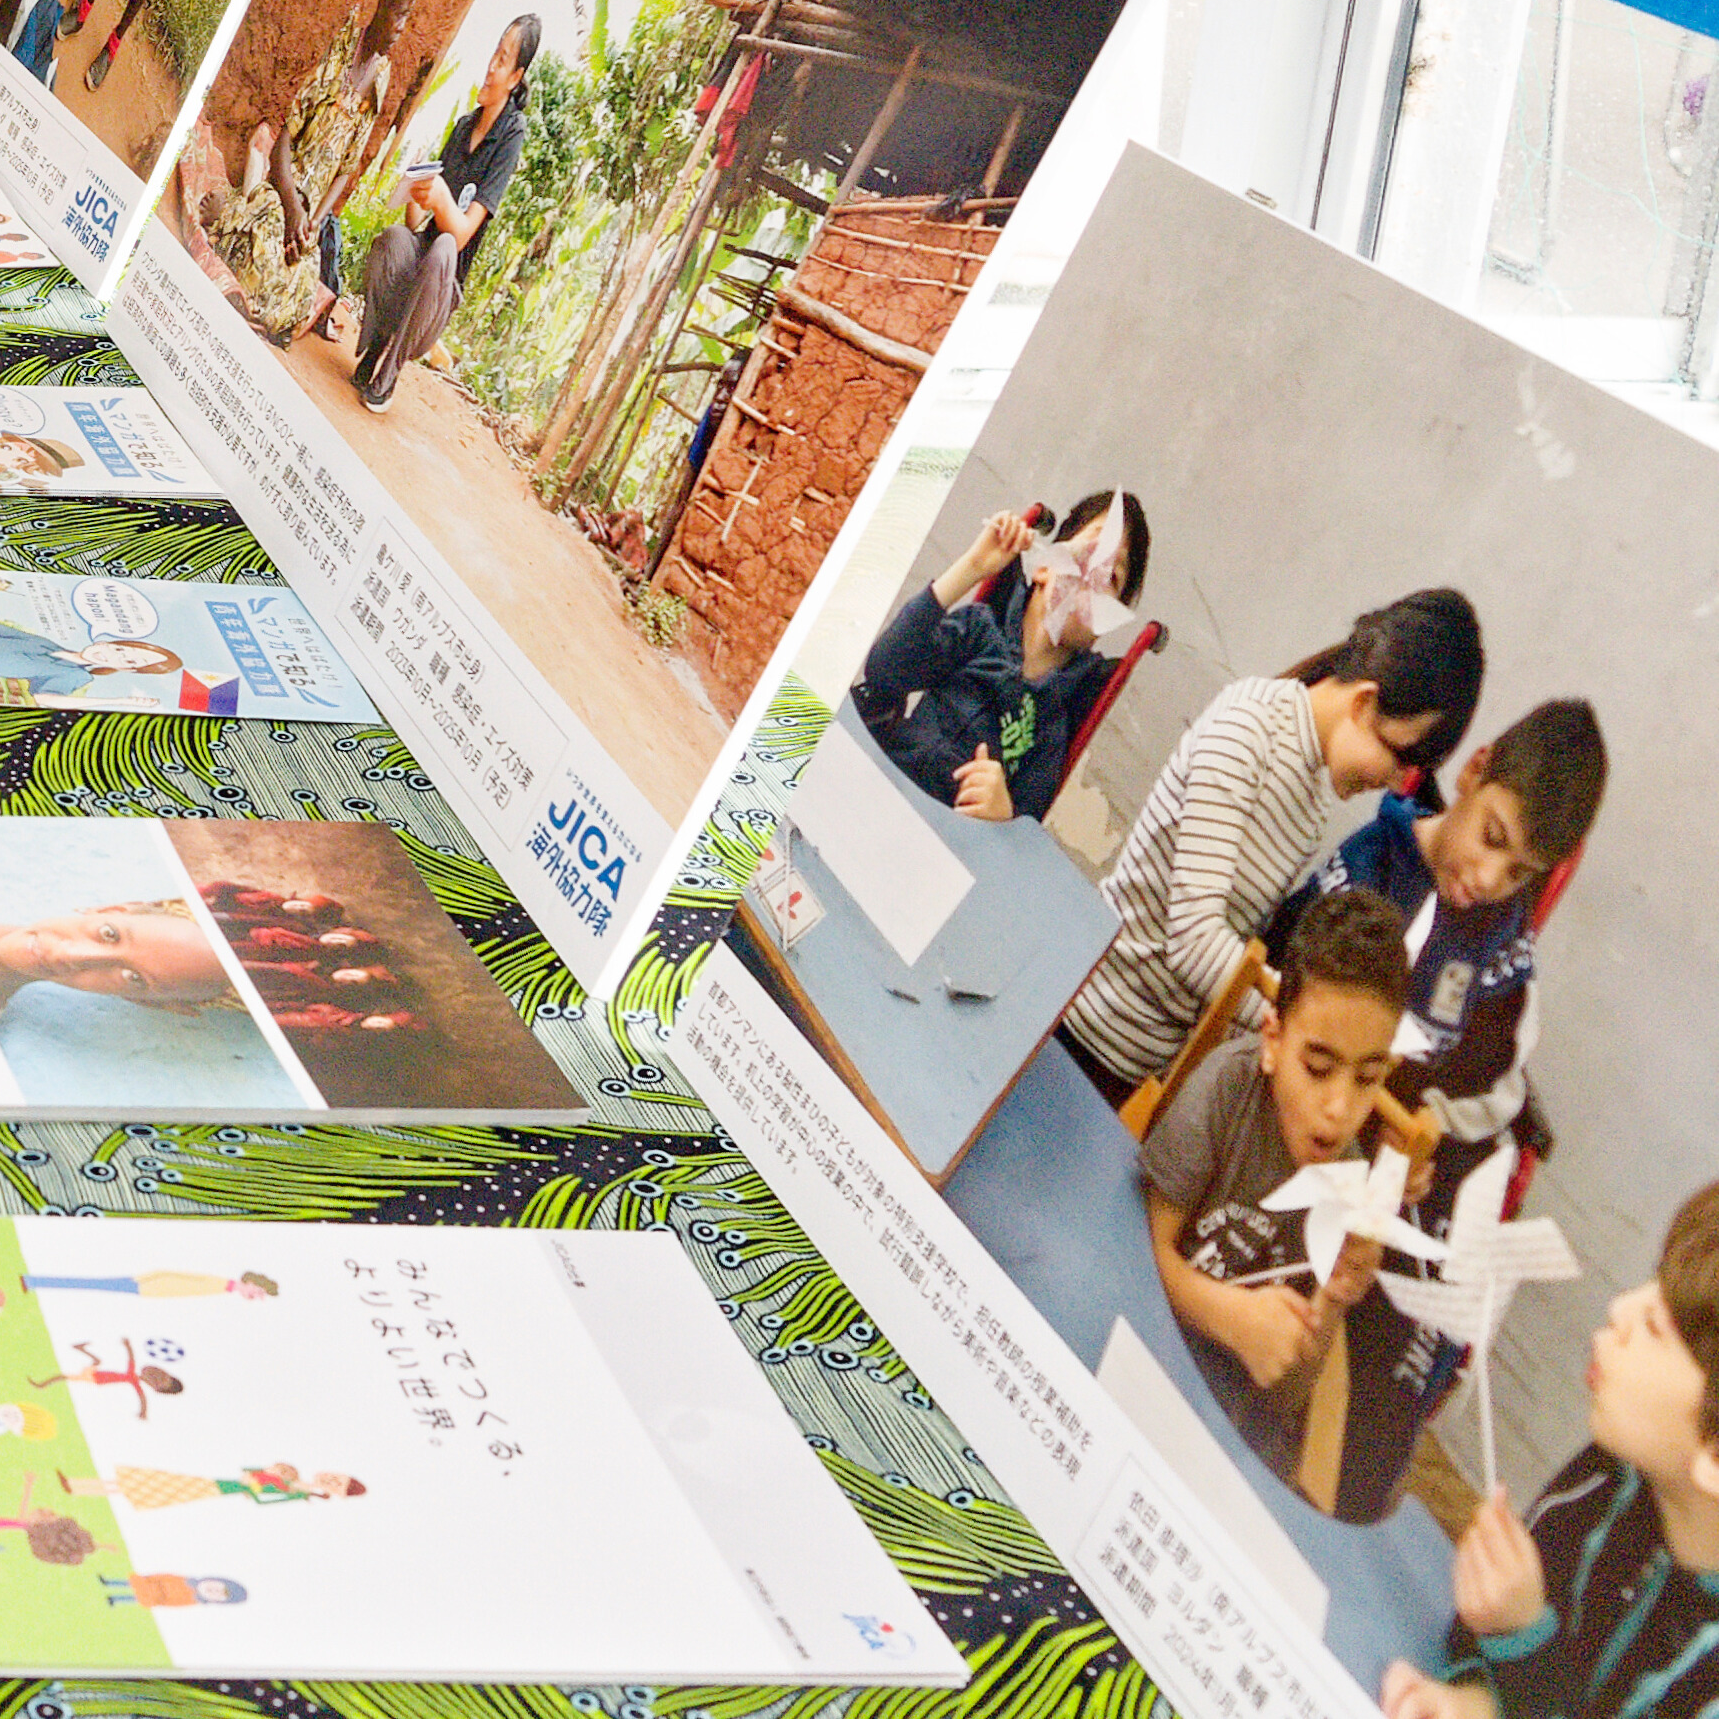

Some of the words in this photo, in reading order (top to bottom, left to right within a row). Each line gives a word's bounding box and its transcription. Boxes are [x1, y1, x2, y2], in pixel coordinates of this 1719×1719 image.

[61, 204, 111, 264] 海外協力隊
[73, 184, 118, 239] JICA
[69, 404, 139, 476] 青年海外協力隊
[109, 413, 164, 468] マンガで知る
[102, 584, 135, 636] Magandang
[348, 591, 386, 646] 派遣期間
[360, 565, 392, 610] 派遣国
[389, 602, 429, 658] ウガンダ
[211, 604, 288, 697] 青年海外協力隊
[256, 616, 317, 689] マンガで知る
[523, 819, 615, 939] 海外協力隊
[547, 795, 628, 903] JICA
[344, 1258, 457, 1448] よりよい世界。
